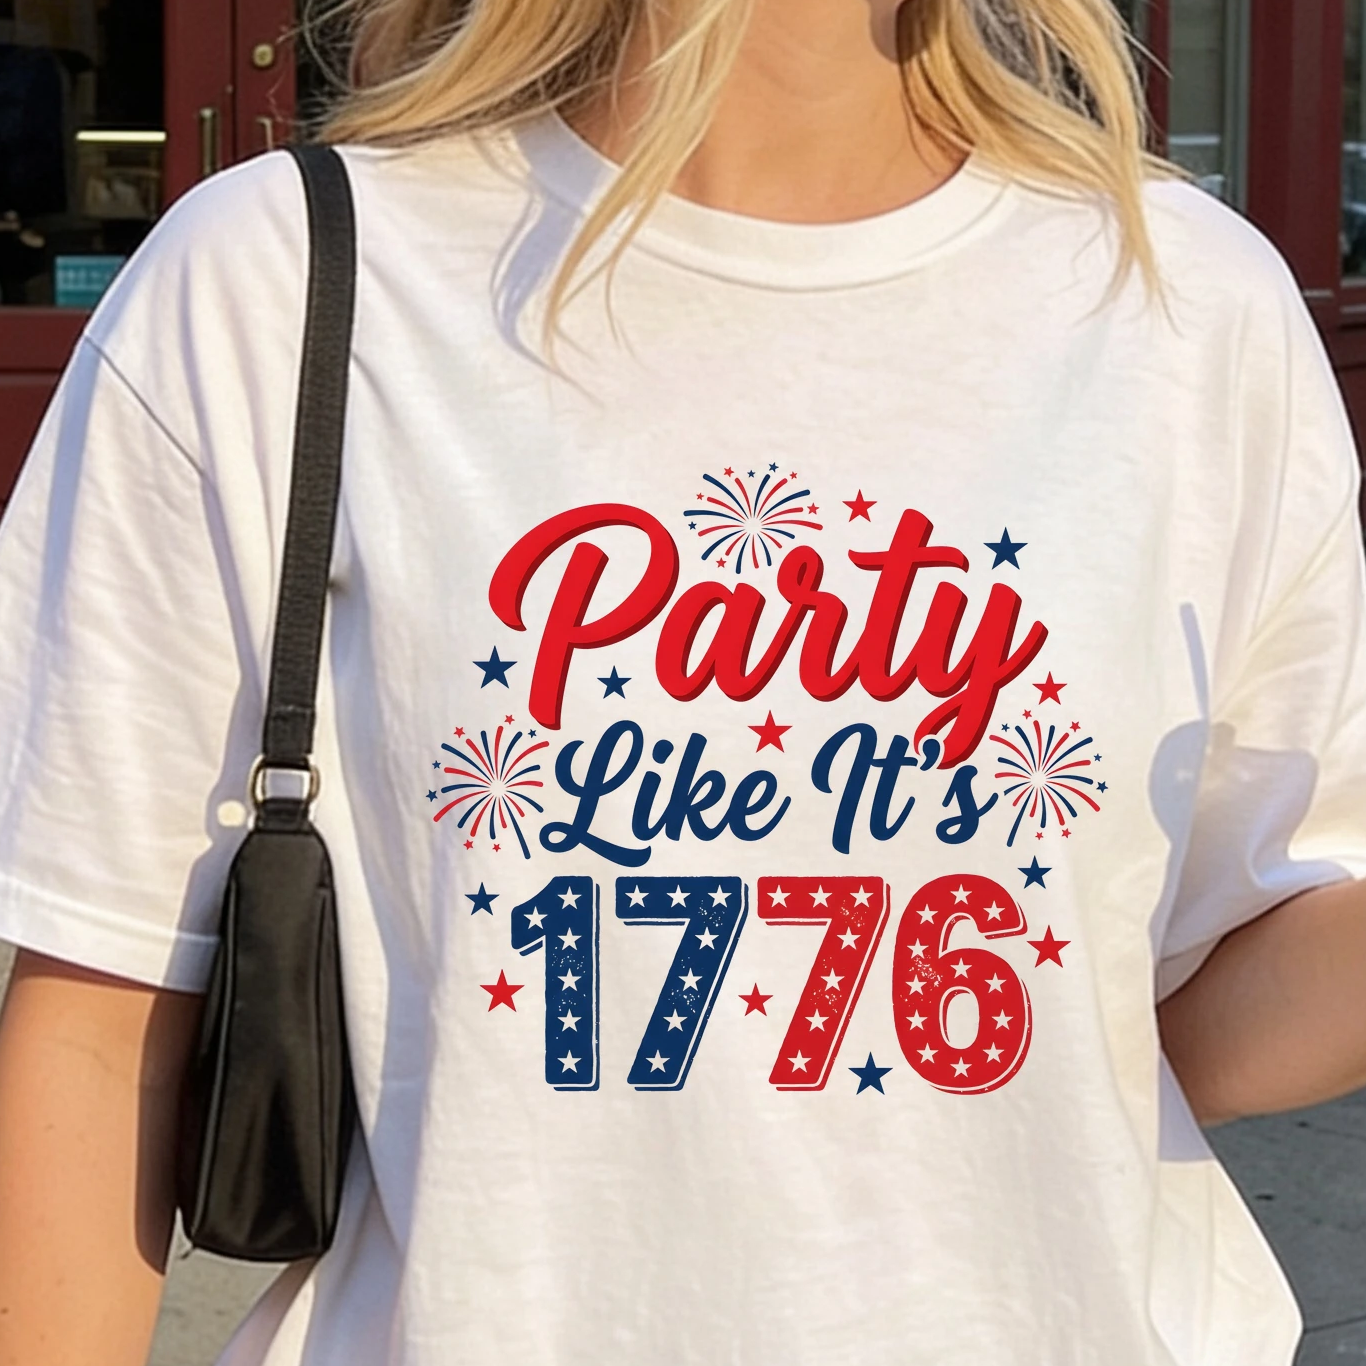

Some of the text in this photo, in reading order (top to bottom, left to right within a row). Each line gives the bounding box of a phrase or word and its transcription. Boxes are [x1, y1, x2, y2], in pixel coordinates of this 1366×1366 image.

[488, 503, 1049, 770] Party
[539, 721, 999, 868] Like It's
[510, 874, 1034, 1096] 1776
